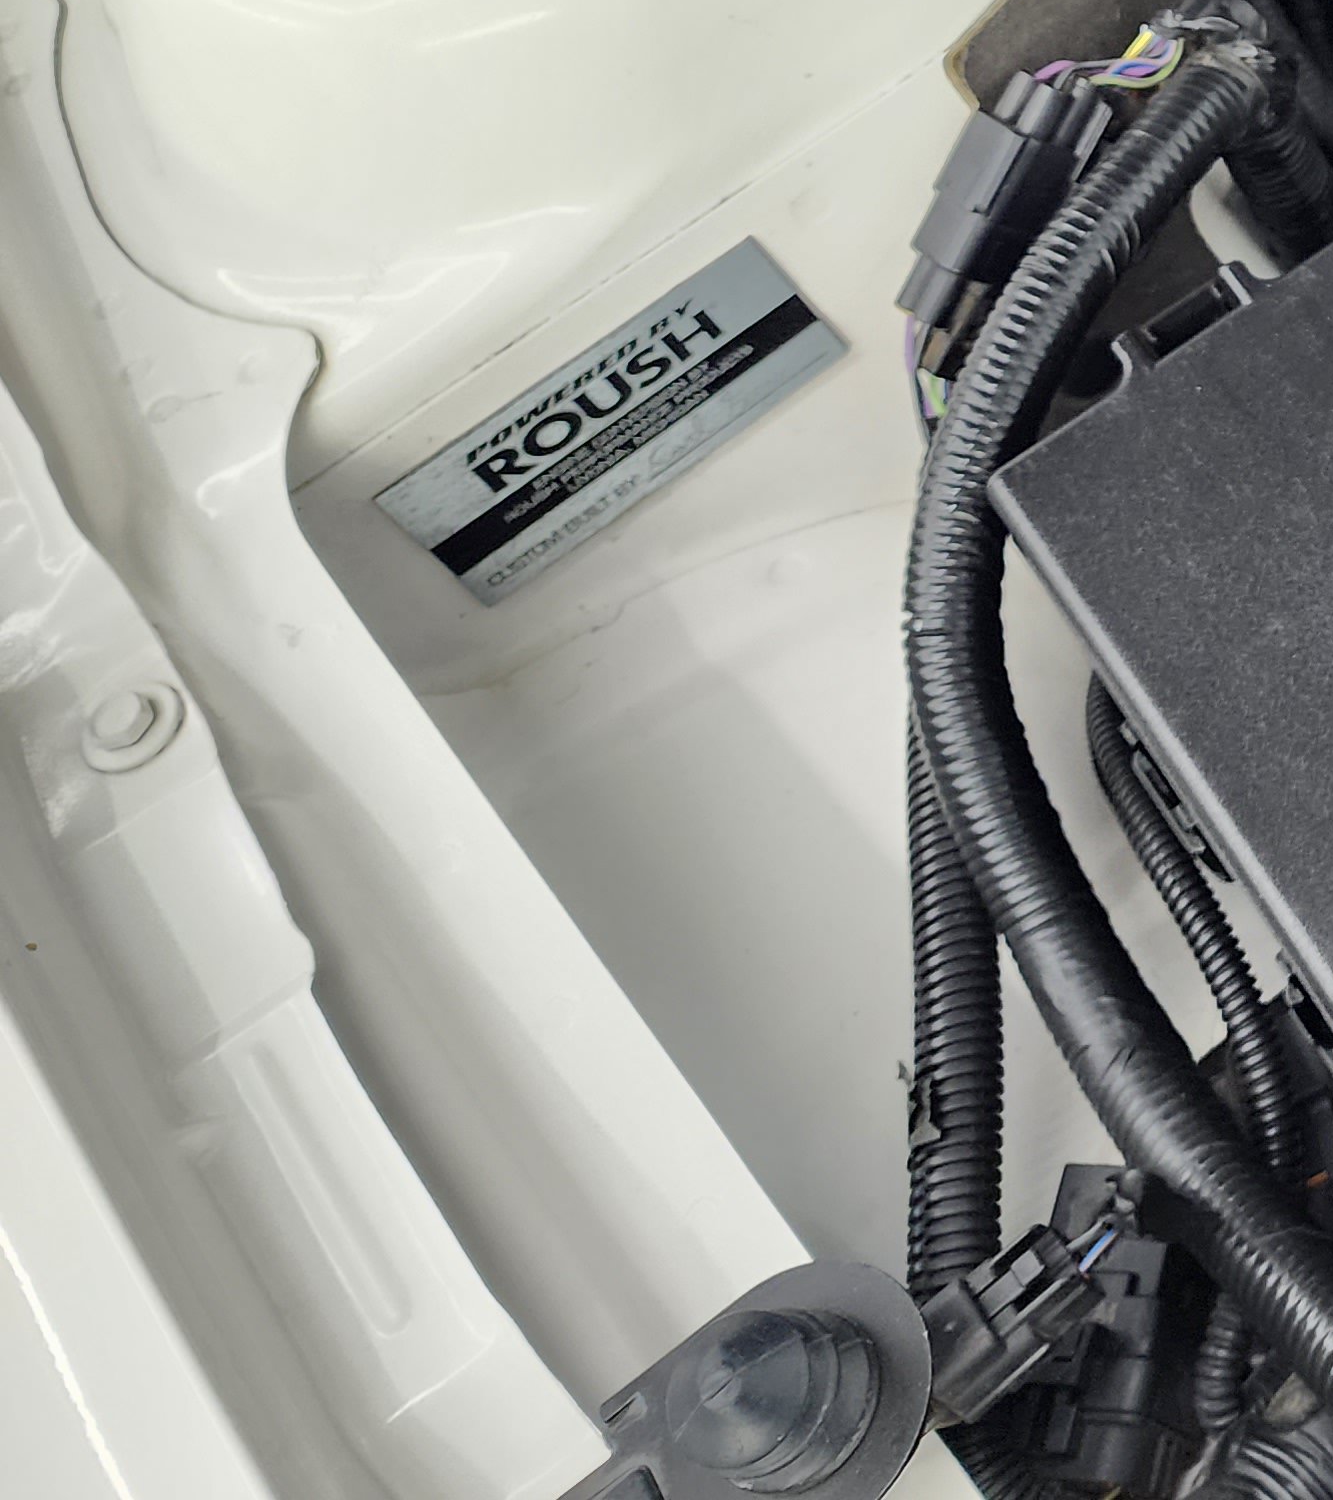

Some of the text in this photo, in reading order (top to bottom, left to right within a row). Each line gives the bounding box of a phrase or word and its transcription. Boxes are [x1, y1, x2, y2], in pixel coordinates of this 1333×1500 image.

[466, 337, 635, 466] POWERED
[648, 299, 690, 339] BY
[471, 309, 722, 494] ROUSH
[485, 529, 563, 589] CUSTOM
[560, 493, 613, 535] BUILT
